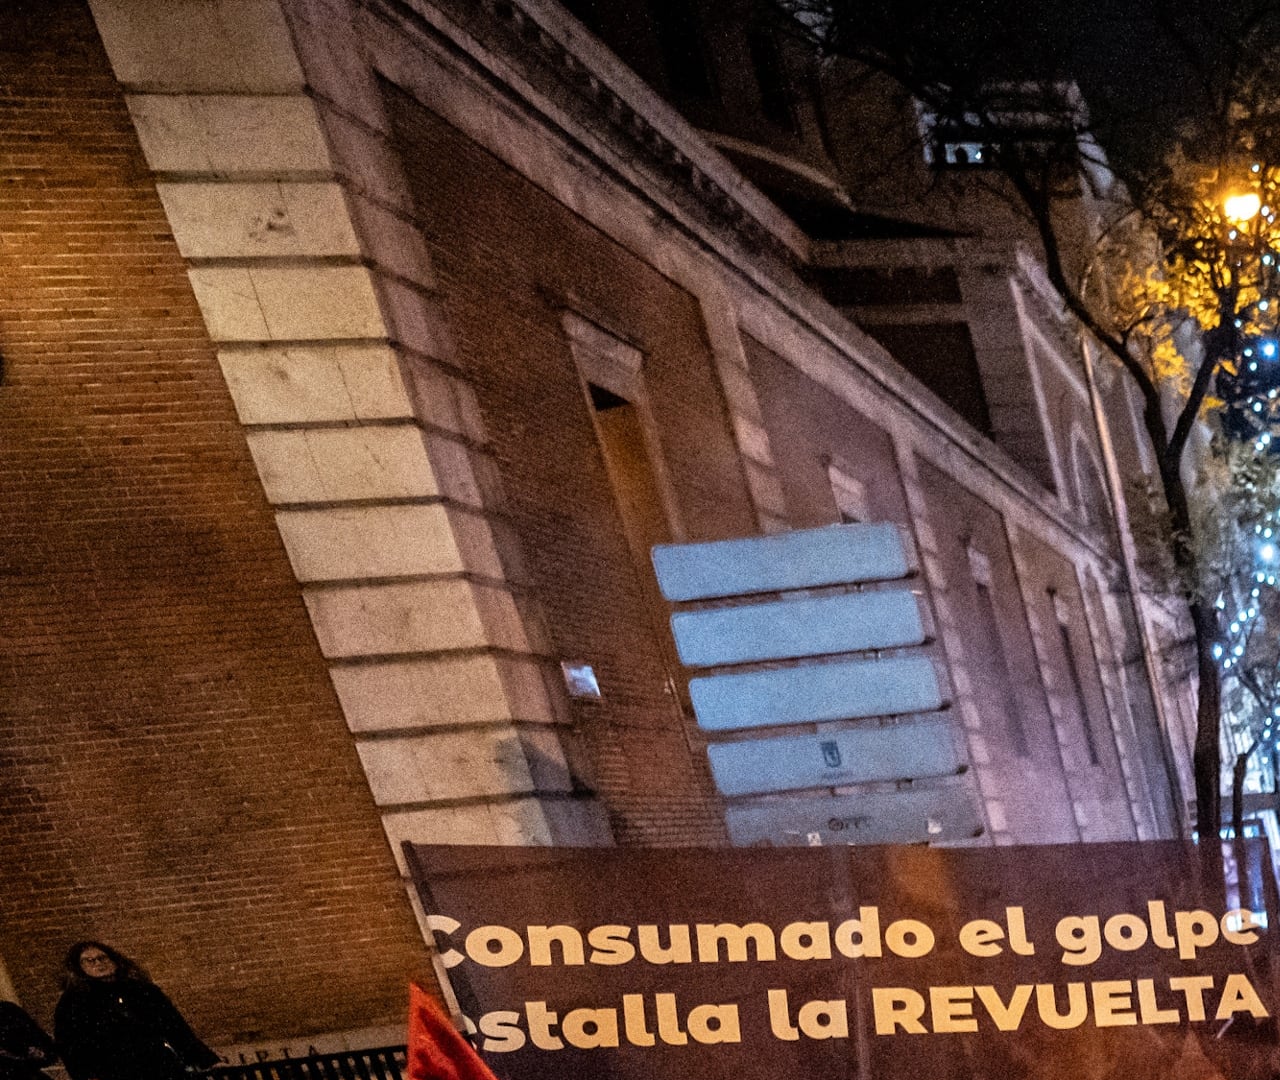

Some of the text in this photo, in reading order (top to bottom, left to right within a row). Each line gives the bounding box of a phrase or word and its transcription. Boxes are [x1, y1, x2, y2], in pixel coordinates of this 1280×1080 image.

[426, 900, 1266, 968] Consumado el golpe
[768, 989, 848, 1041] la
[872, 973, 1269, 1036] REVUELTA
